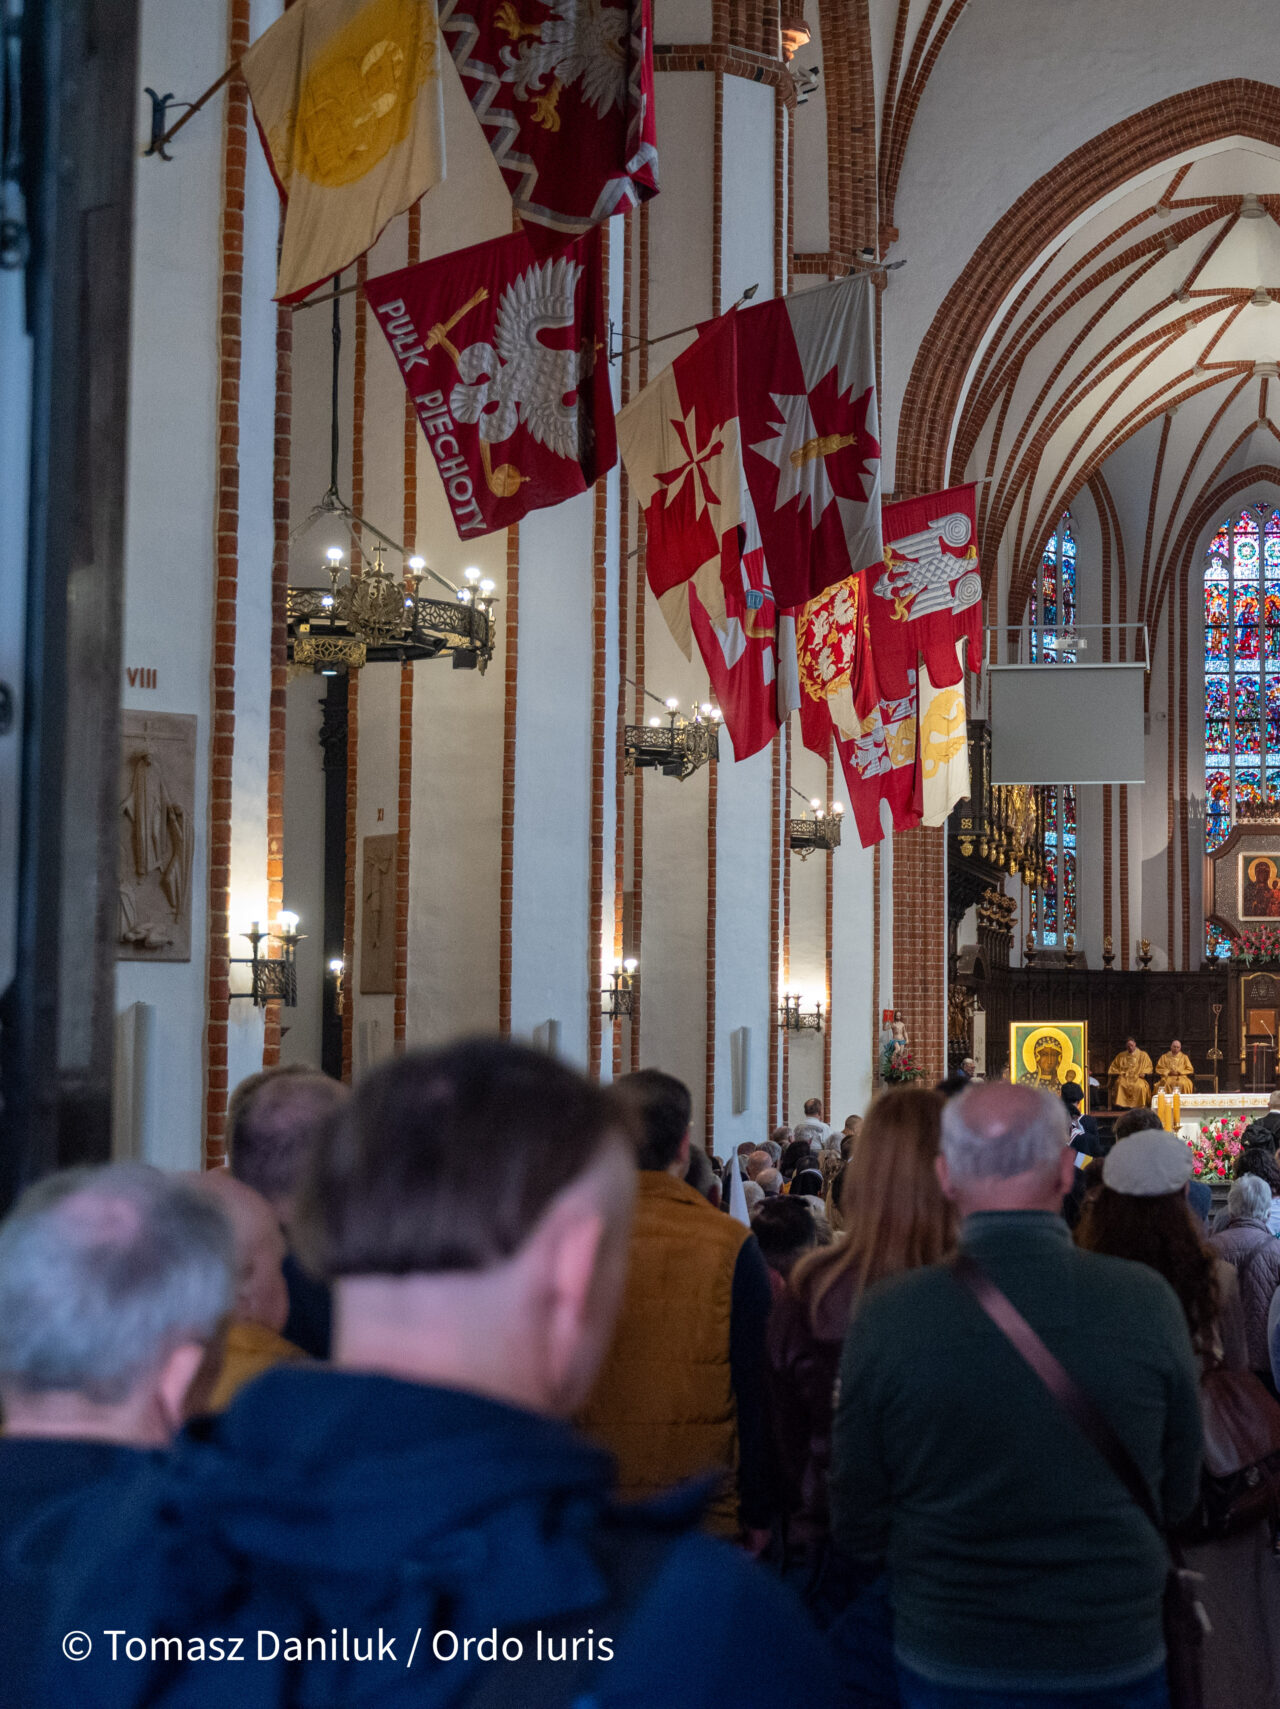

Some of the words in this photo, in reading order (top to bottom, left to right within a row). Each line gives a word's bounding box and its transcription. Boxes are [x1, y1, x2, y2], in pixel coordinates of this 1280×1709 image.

[376, 297, 430, 373] PUŁK
[416, 389, 488, 532] PIECHOTY
[126, 667, 158, 690] VIII
